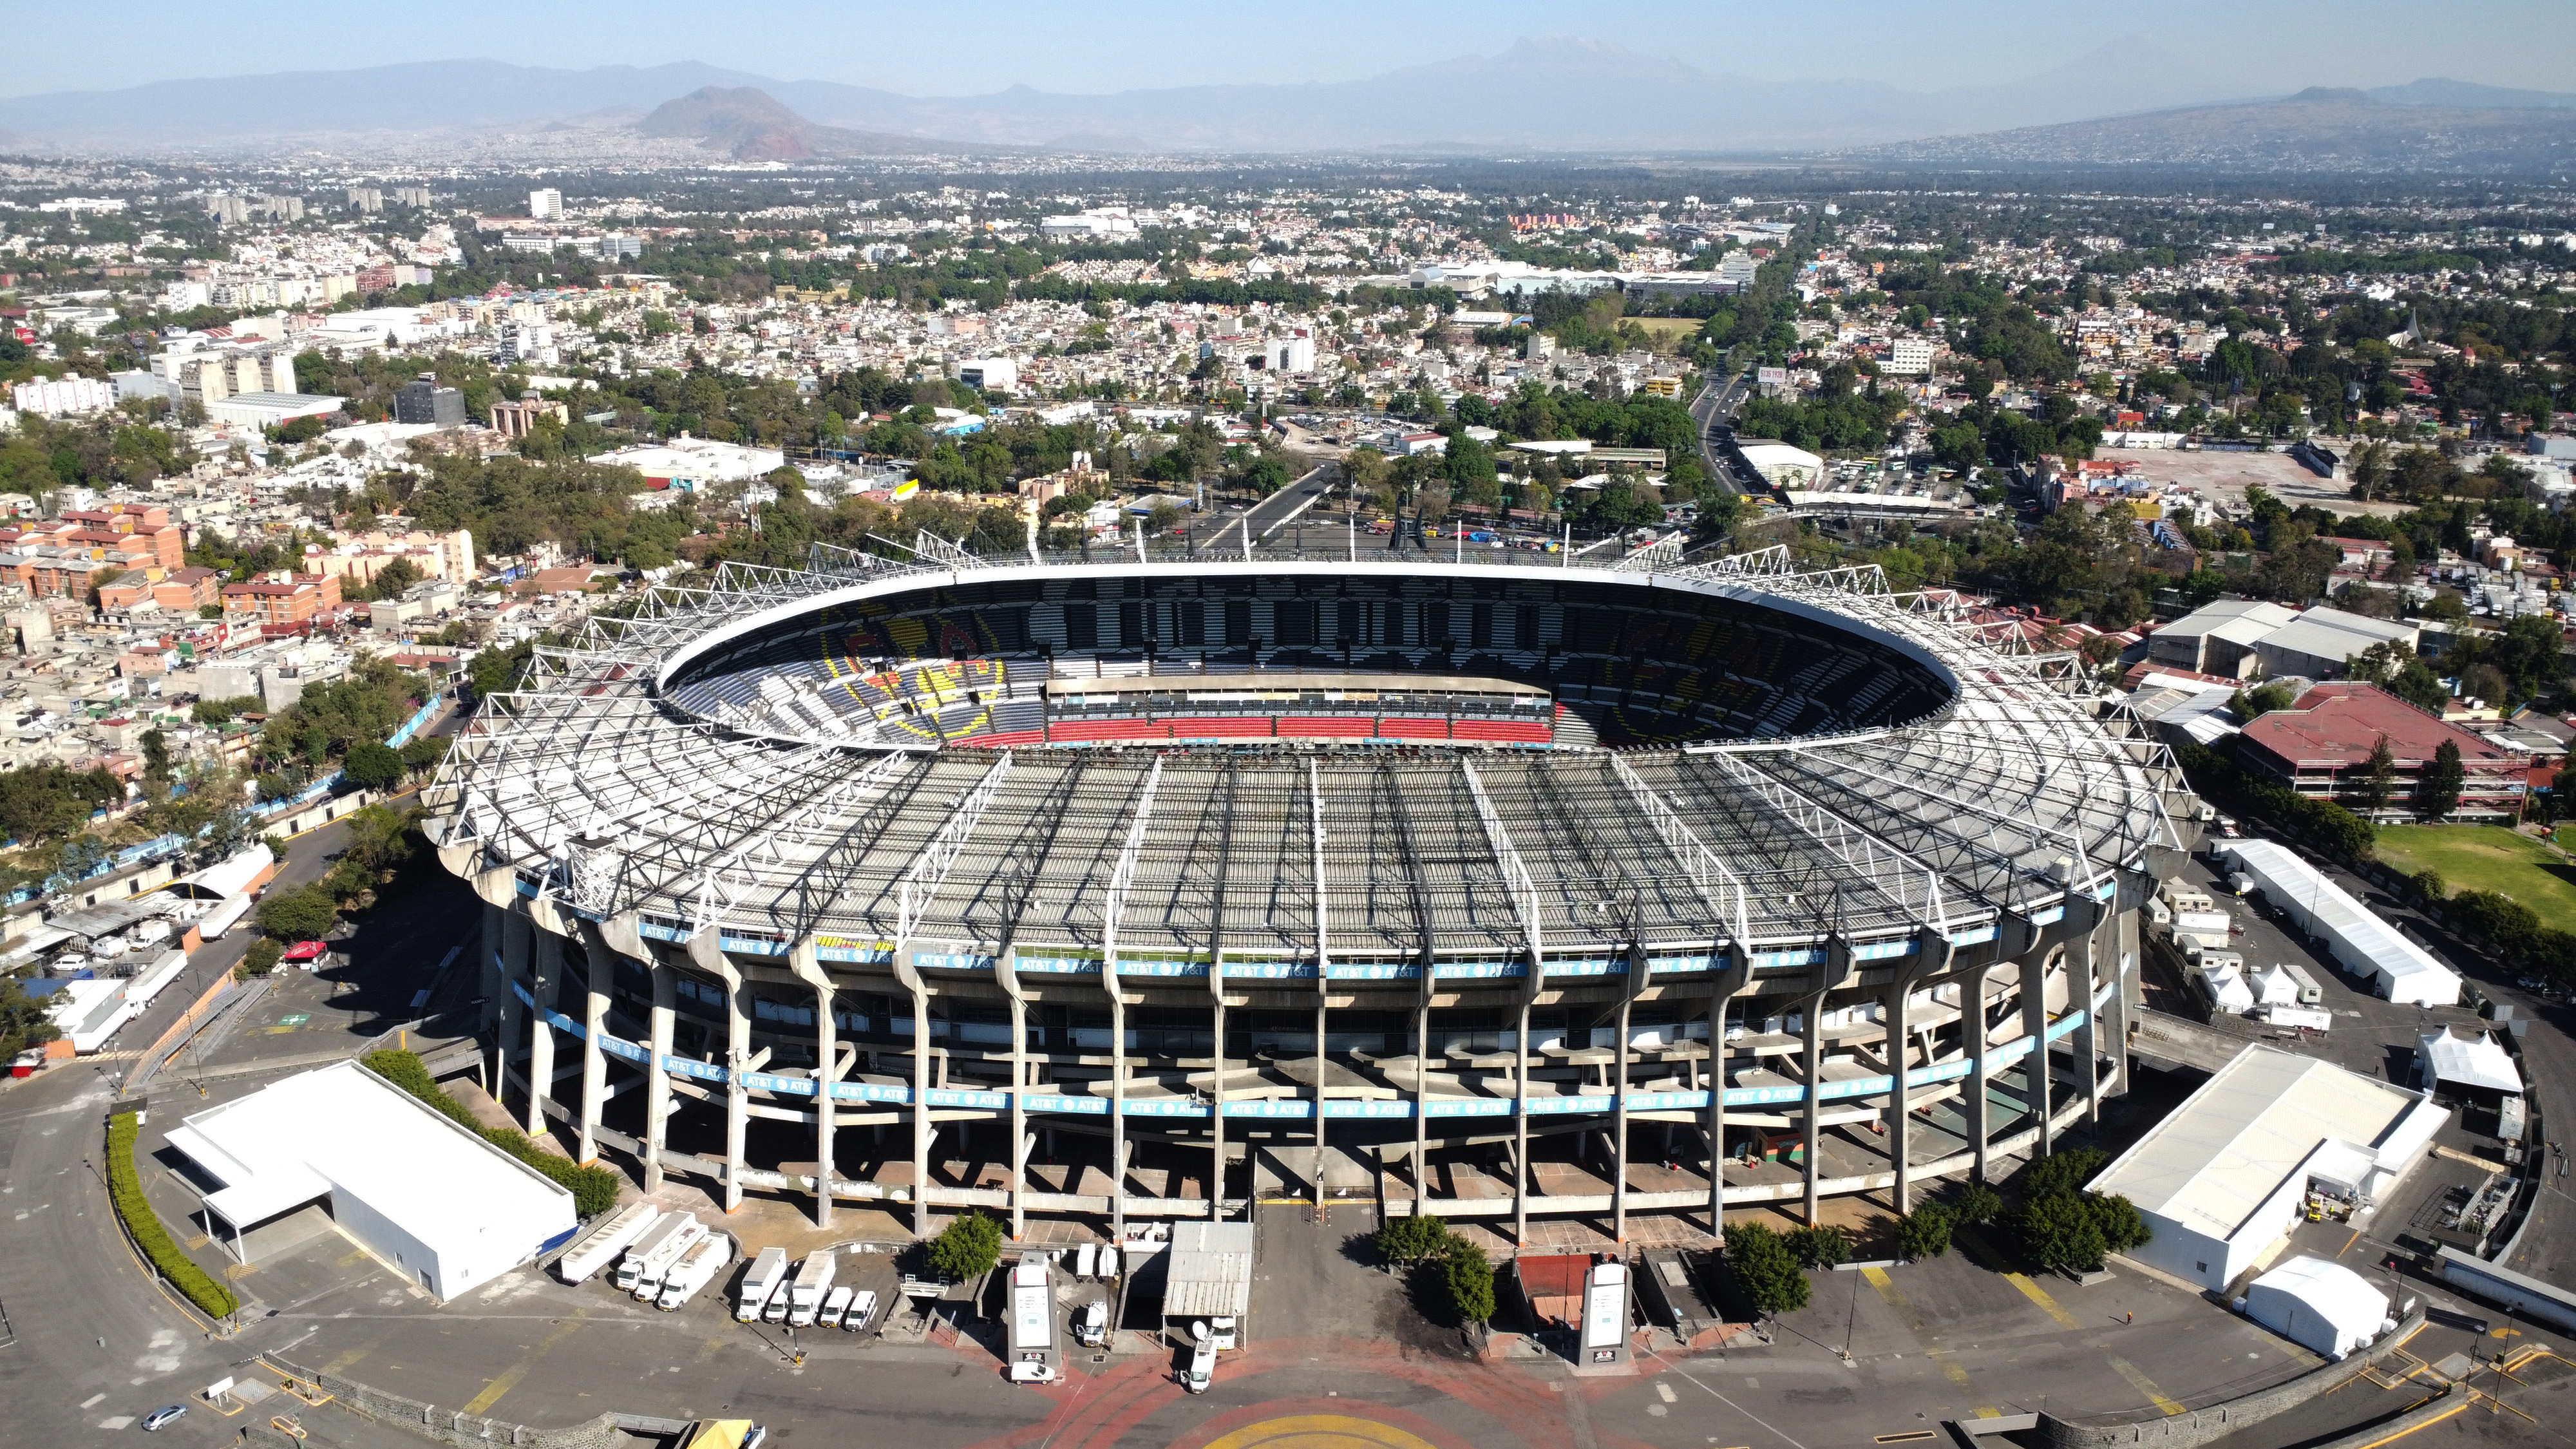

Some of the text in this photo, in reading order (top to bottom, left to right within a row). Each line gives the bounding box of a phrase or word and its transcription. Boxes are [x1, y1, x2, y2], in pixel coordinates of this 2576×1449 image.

[645, 928, 668, 939] AT&T
[728, 939, 754, 952] AT&T
[820, 949, 850, 960] AT&T
[919, 955, 949, 965] AT&T
[1021, 960, 1051, 971] AT&T
[1124, 962, 1204, 975] AT&T AT&T
[1229, 965, 1261, 976] AT&T
[1439, 965, 1470, 977] AT&T
[1334, 967, 1365, 978] AT&T
[602, 1039, 620, 1051] AT&T
[668, 1061, 690, 1073] AT&T
[747, 1077, 773, 1088] AT&T
[838, 1086, 864, 1097] AT&T
[1727, 1088, 1802, 1103] AT&T AT&T
[931, 1094, 1005, 1106] AT&T AT&T
[1030, 1098, 1106, 1111] AT&T AT&T
[1630, 1094, 1704, 1106] AT&T AT&T
[1129, 1103, 1158, 1113] AT&T
[1230, 1104, 1307, 1115] AT&T AT&T
[1331, 1104, 1410, 1115] AT&T AT&T
[1432, 1103, 1510, 1114] AT&T AT&T
